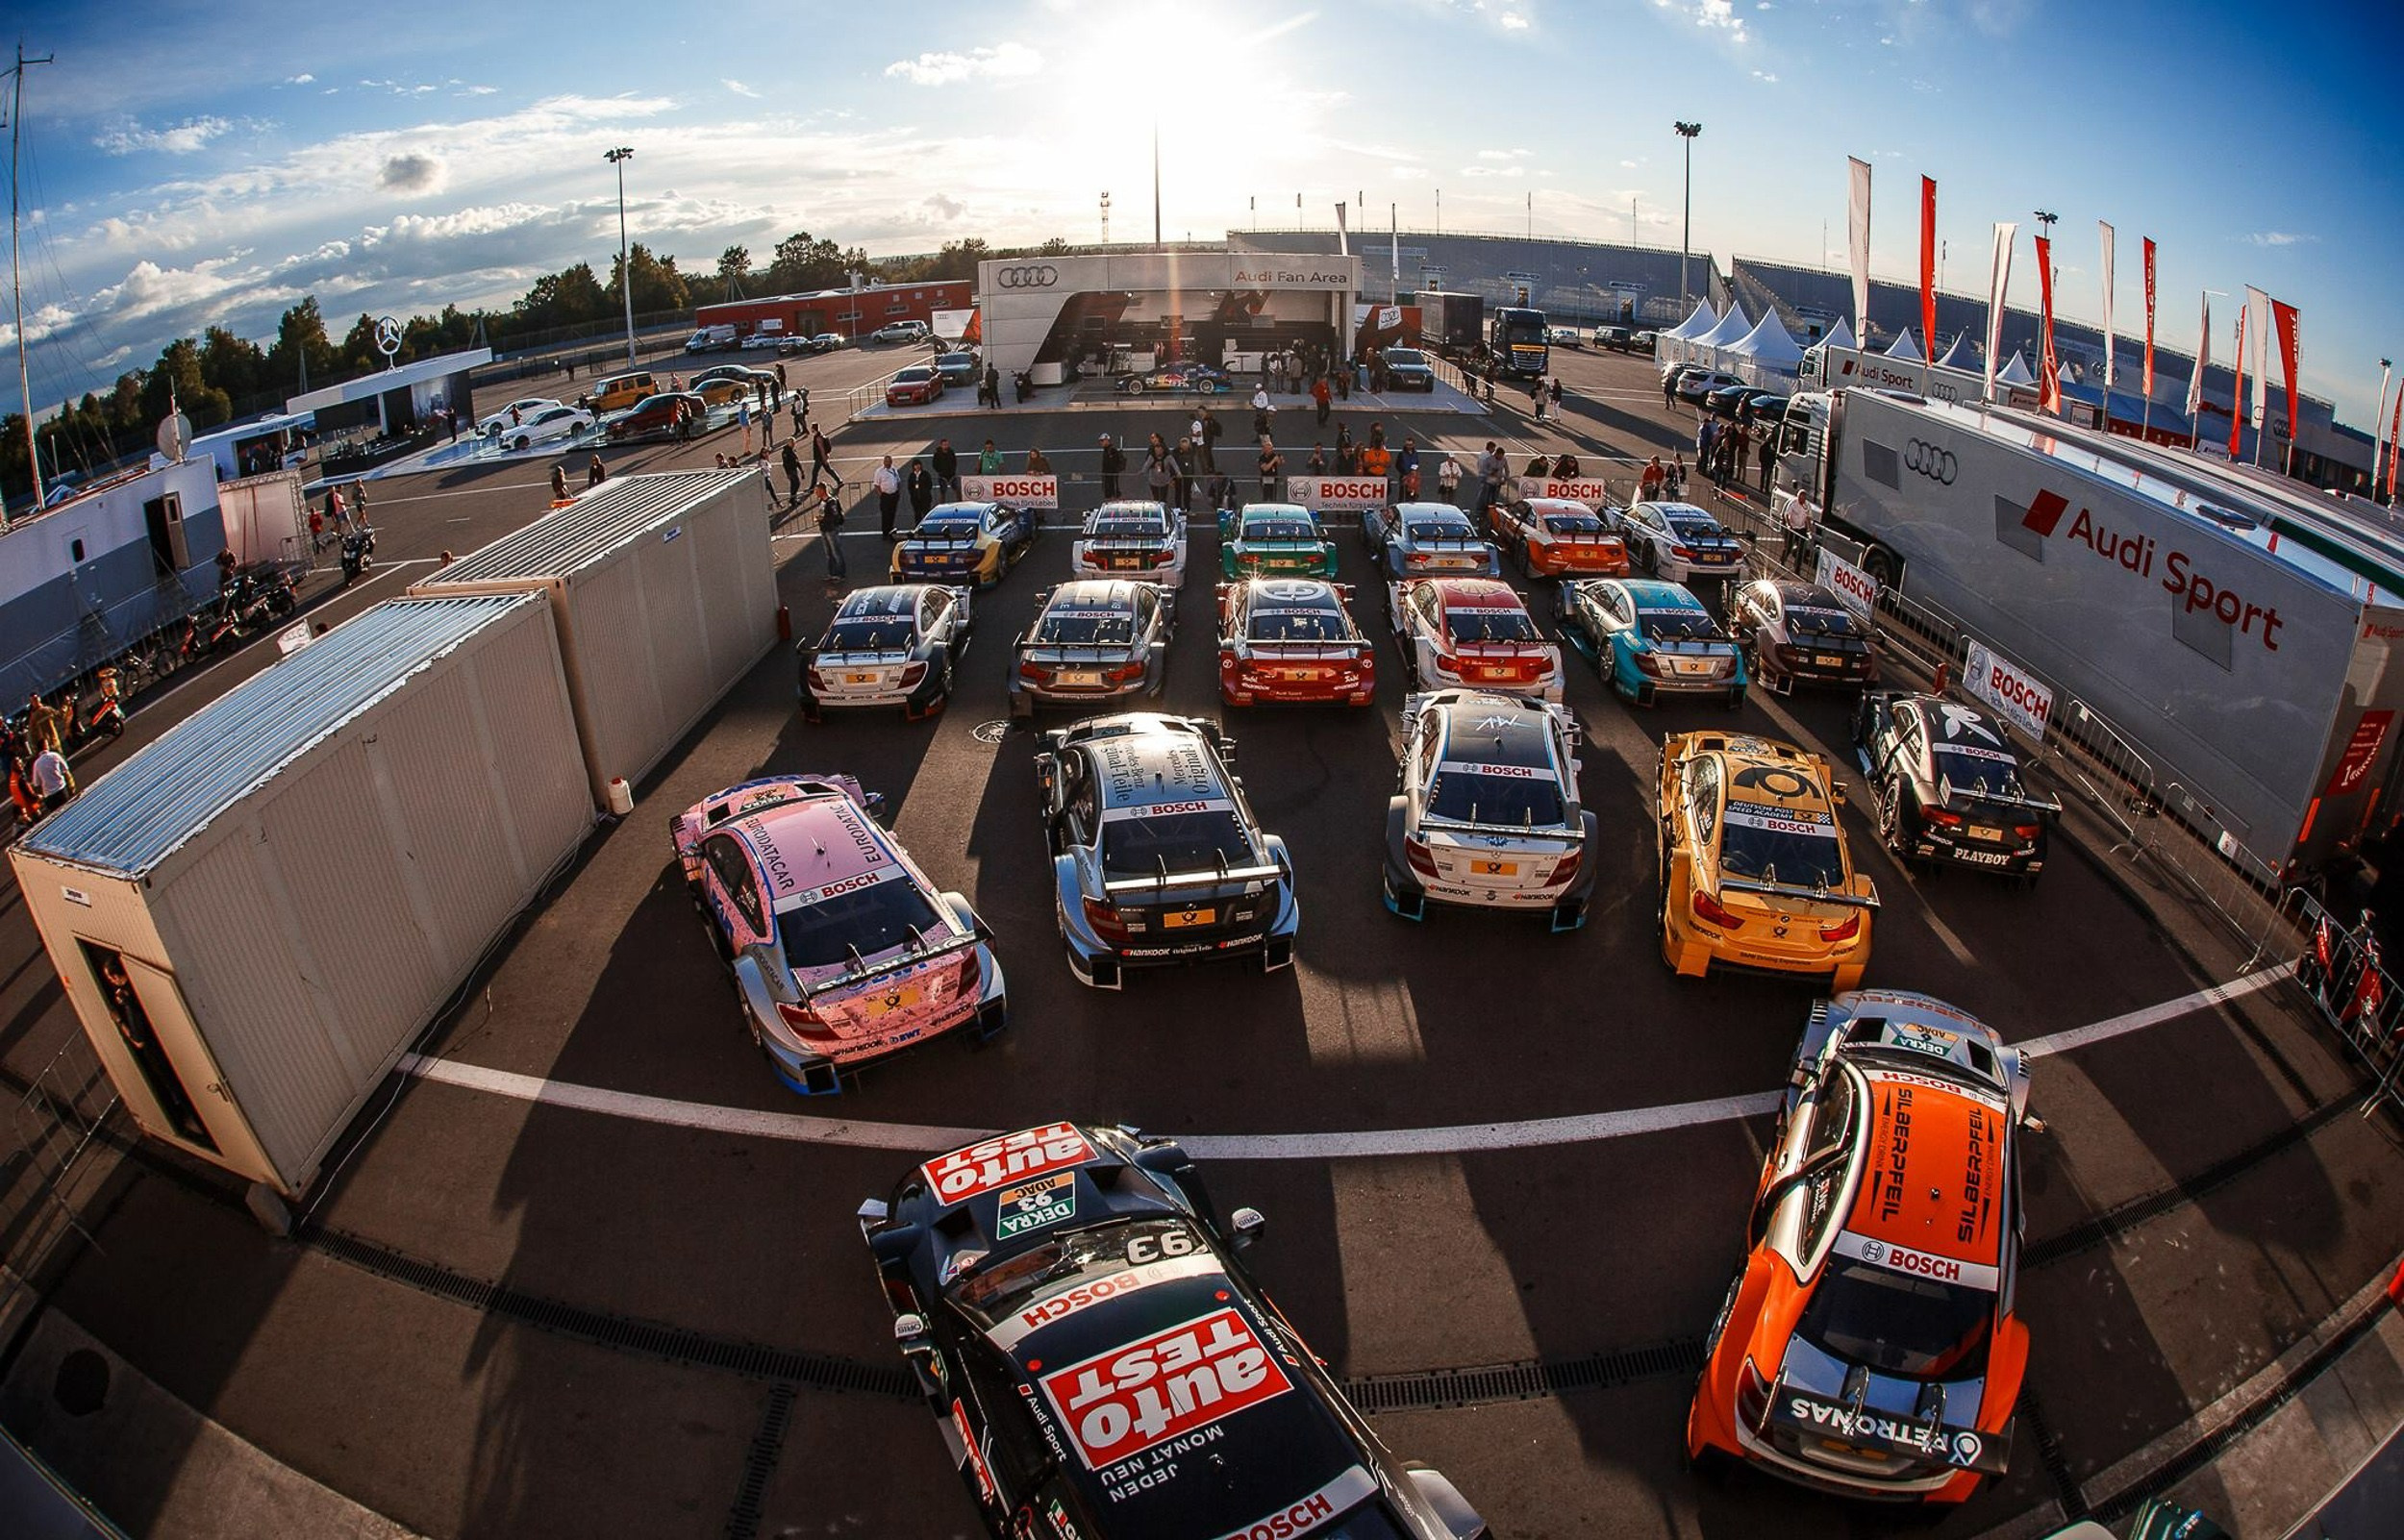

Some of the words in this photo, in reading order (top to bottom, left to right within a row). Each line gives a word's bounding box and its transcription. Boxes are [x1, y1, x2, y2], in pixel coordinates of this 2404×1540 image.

[1235, 271, 1272, 283] Audi
[1278, 271, 1305, 284] Fan
[1309, 271, 1348, 284] Area
[1854, 362, 1880, 381] Audi
[1882, 368, 1915, 389] Sport
[993, 482, 1055, 497] BOSCH
[1320, 483, 1385, 499] BOSCH
[1547, 482, 1602, 498] BOSCH
[1834, 565, 1874, 604] BOSCH
[2066, 507, 2155, 578] Audi
[2161, 551, 2284, 652] Sport
[1991, 666, 2048, 721] BOSCH
[1965, 747, 2001, 760] BOSCH
[1482, 764, 1533, 777] BOSCH
[1151, 802, 1208, 815] BOSCH
[1727, 805, 1754, 814] SPEED
[1754, 808, 1794, 820] ACADEMY
[1733, 801, 1773, 812] DEUTSCHE
[1767, 820, 1816, 834] BOSCH
[746, 817, 796, 890] EURODATACAR
[1953, 847, 2010, 865] PLAYBOY
[821, 872, 881, 898] BOSCH
[1757, 954, 1778, 963] Driving
[1779, 957, 1813, 966] Experience
[1898, 1036, 1944, 1056] DEKRA
[1917, 1024, 1946, 1038] ADAC
[1882, 1071, 1962, 1095] BOSCH
[1877, 1116, 1891, 1147] ENERGY
[941, 1125, 1078, 1174] TEST
[1875, 1145, 1887, 1170] DRINK
[1882, 1087, 1914, 1222] SILBERPFEIL
[940, 1137, 1084, 1194] auto
[1957, 1107, 1983, 1245] SILBERPFEIL
[1014, 1177, 1057, 1199] ADAC
[1017, 1190, 1054, 1211] 93
[1003, 1201, 1073, 1233] DEKRA
[1127, 1230, 1193, 1264] 93
[1889, 1249, 1961, 1280] BOSCH
[1021, 1274, 1140, 1329] BOSCH
[1242, 1298, 1268, 1329] Sport
[1263, 1324, 1286, 1355] Audi
[1070, 1318, 1252, 1409] TEST
[1080, 1347, 1267, 1451] auto
[1027, 1398, 1049, 1425] Audi
[1043, 1424, 1067, 1462] Sport
[1790, 1396, 1949, 1453] PETRONAS
[1152, 1424, 1225, 1467] MONAT
[1101, 1455, 1145, 1485] NEU
[1109, 1462, 1179, 1503] JEDEN
[1226, 1493, 1335, 1540] OSCH
